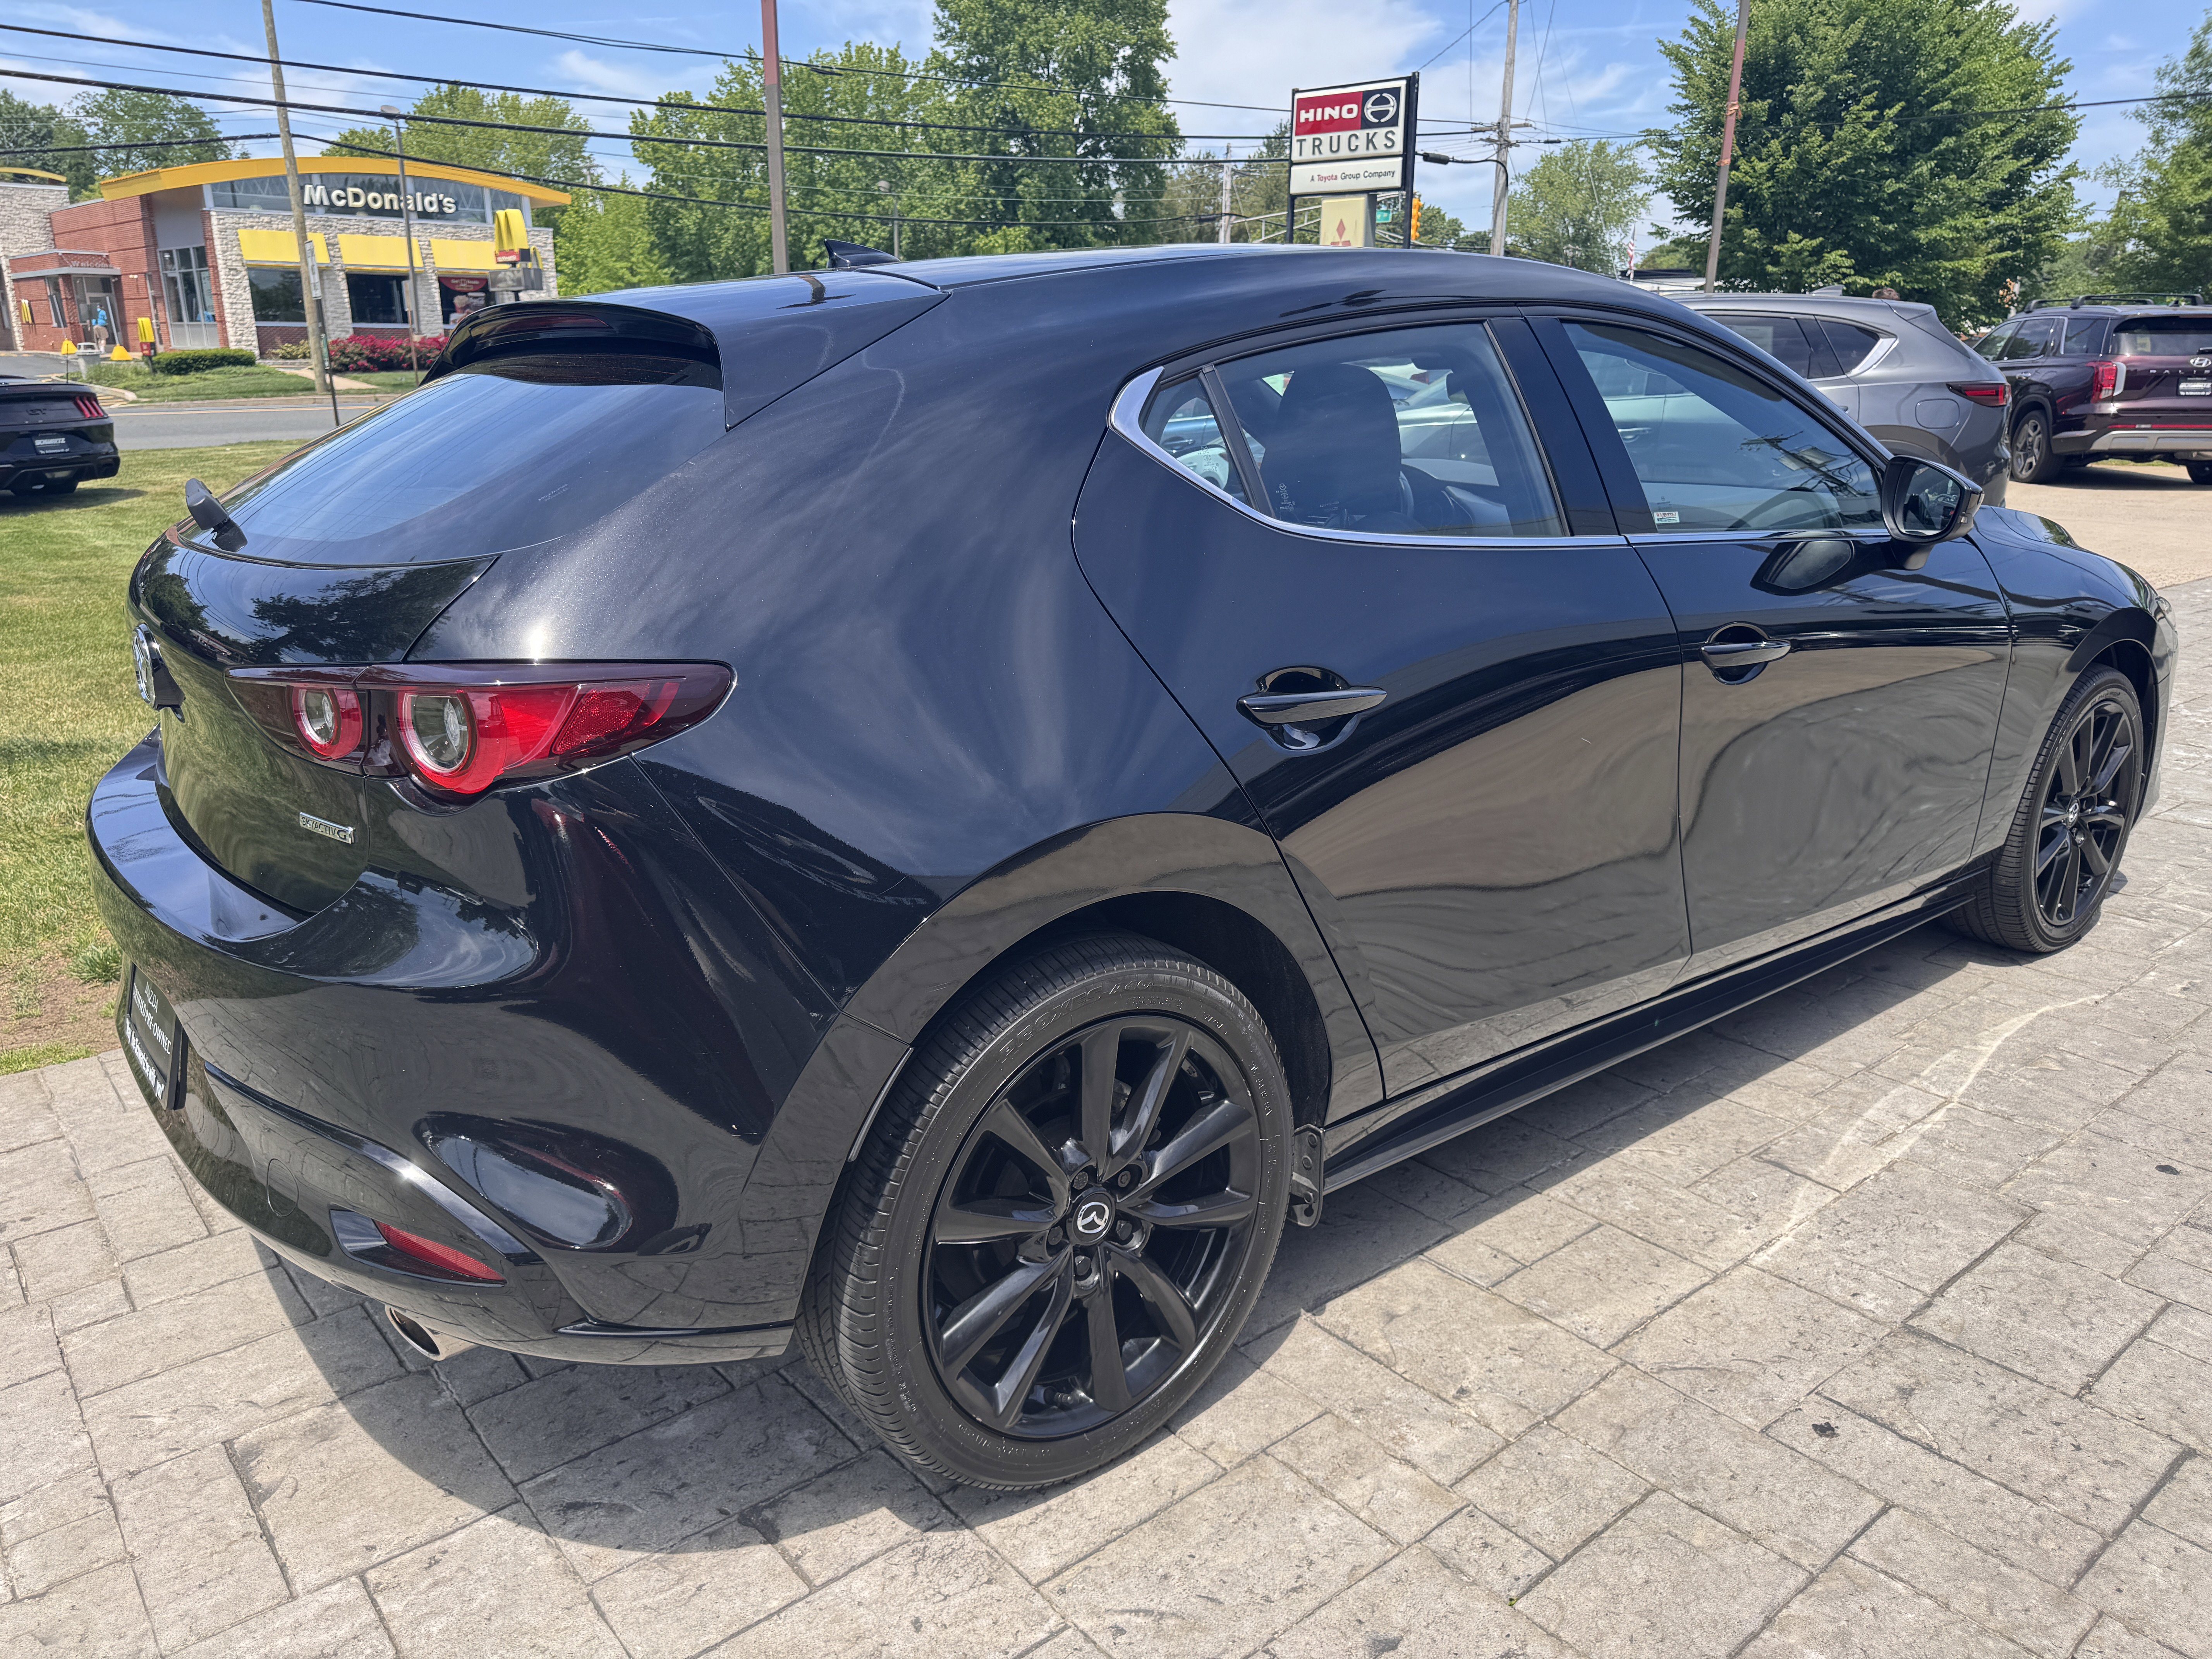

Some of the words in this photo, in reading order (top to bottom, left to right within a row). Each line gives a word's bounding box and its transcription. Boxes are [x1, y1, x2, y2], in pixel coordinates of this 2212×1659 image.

[1300, 104, 1358, 123] HINO
[1296, 130, 1396, 156] TRUCKS
[1317, 174, 1338, 182] Toyota
[1363, 170, 1395, 178] Company
[304, 184, 457, 214] McDonald's
